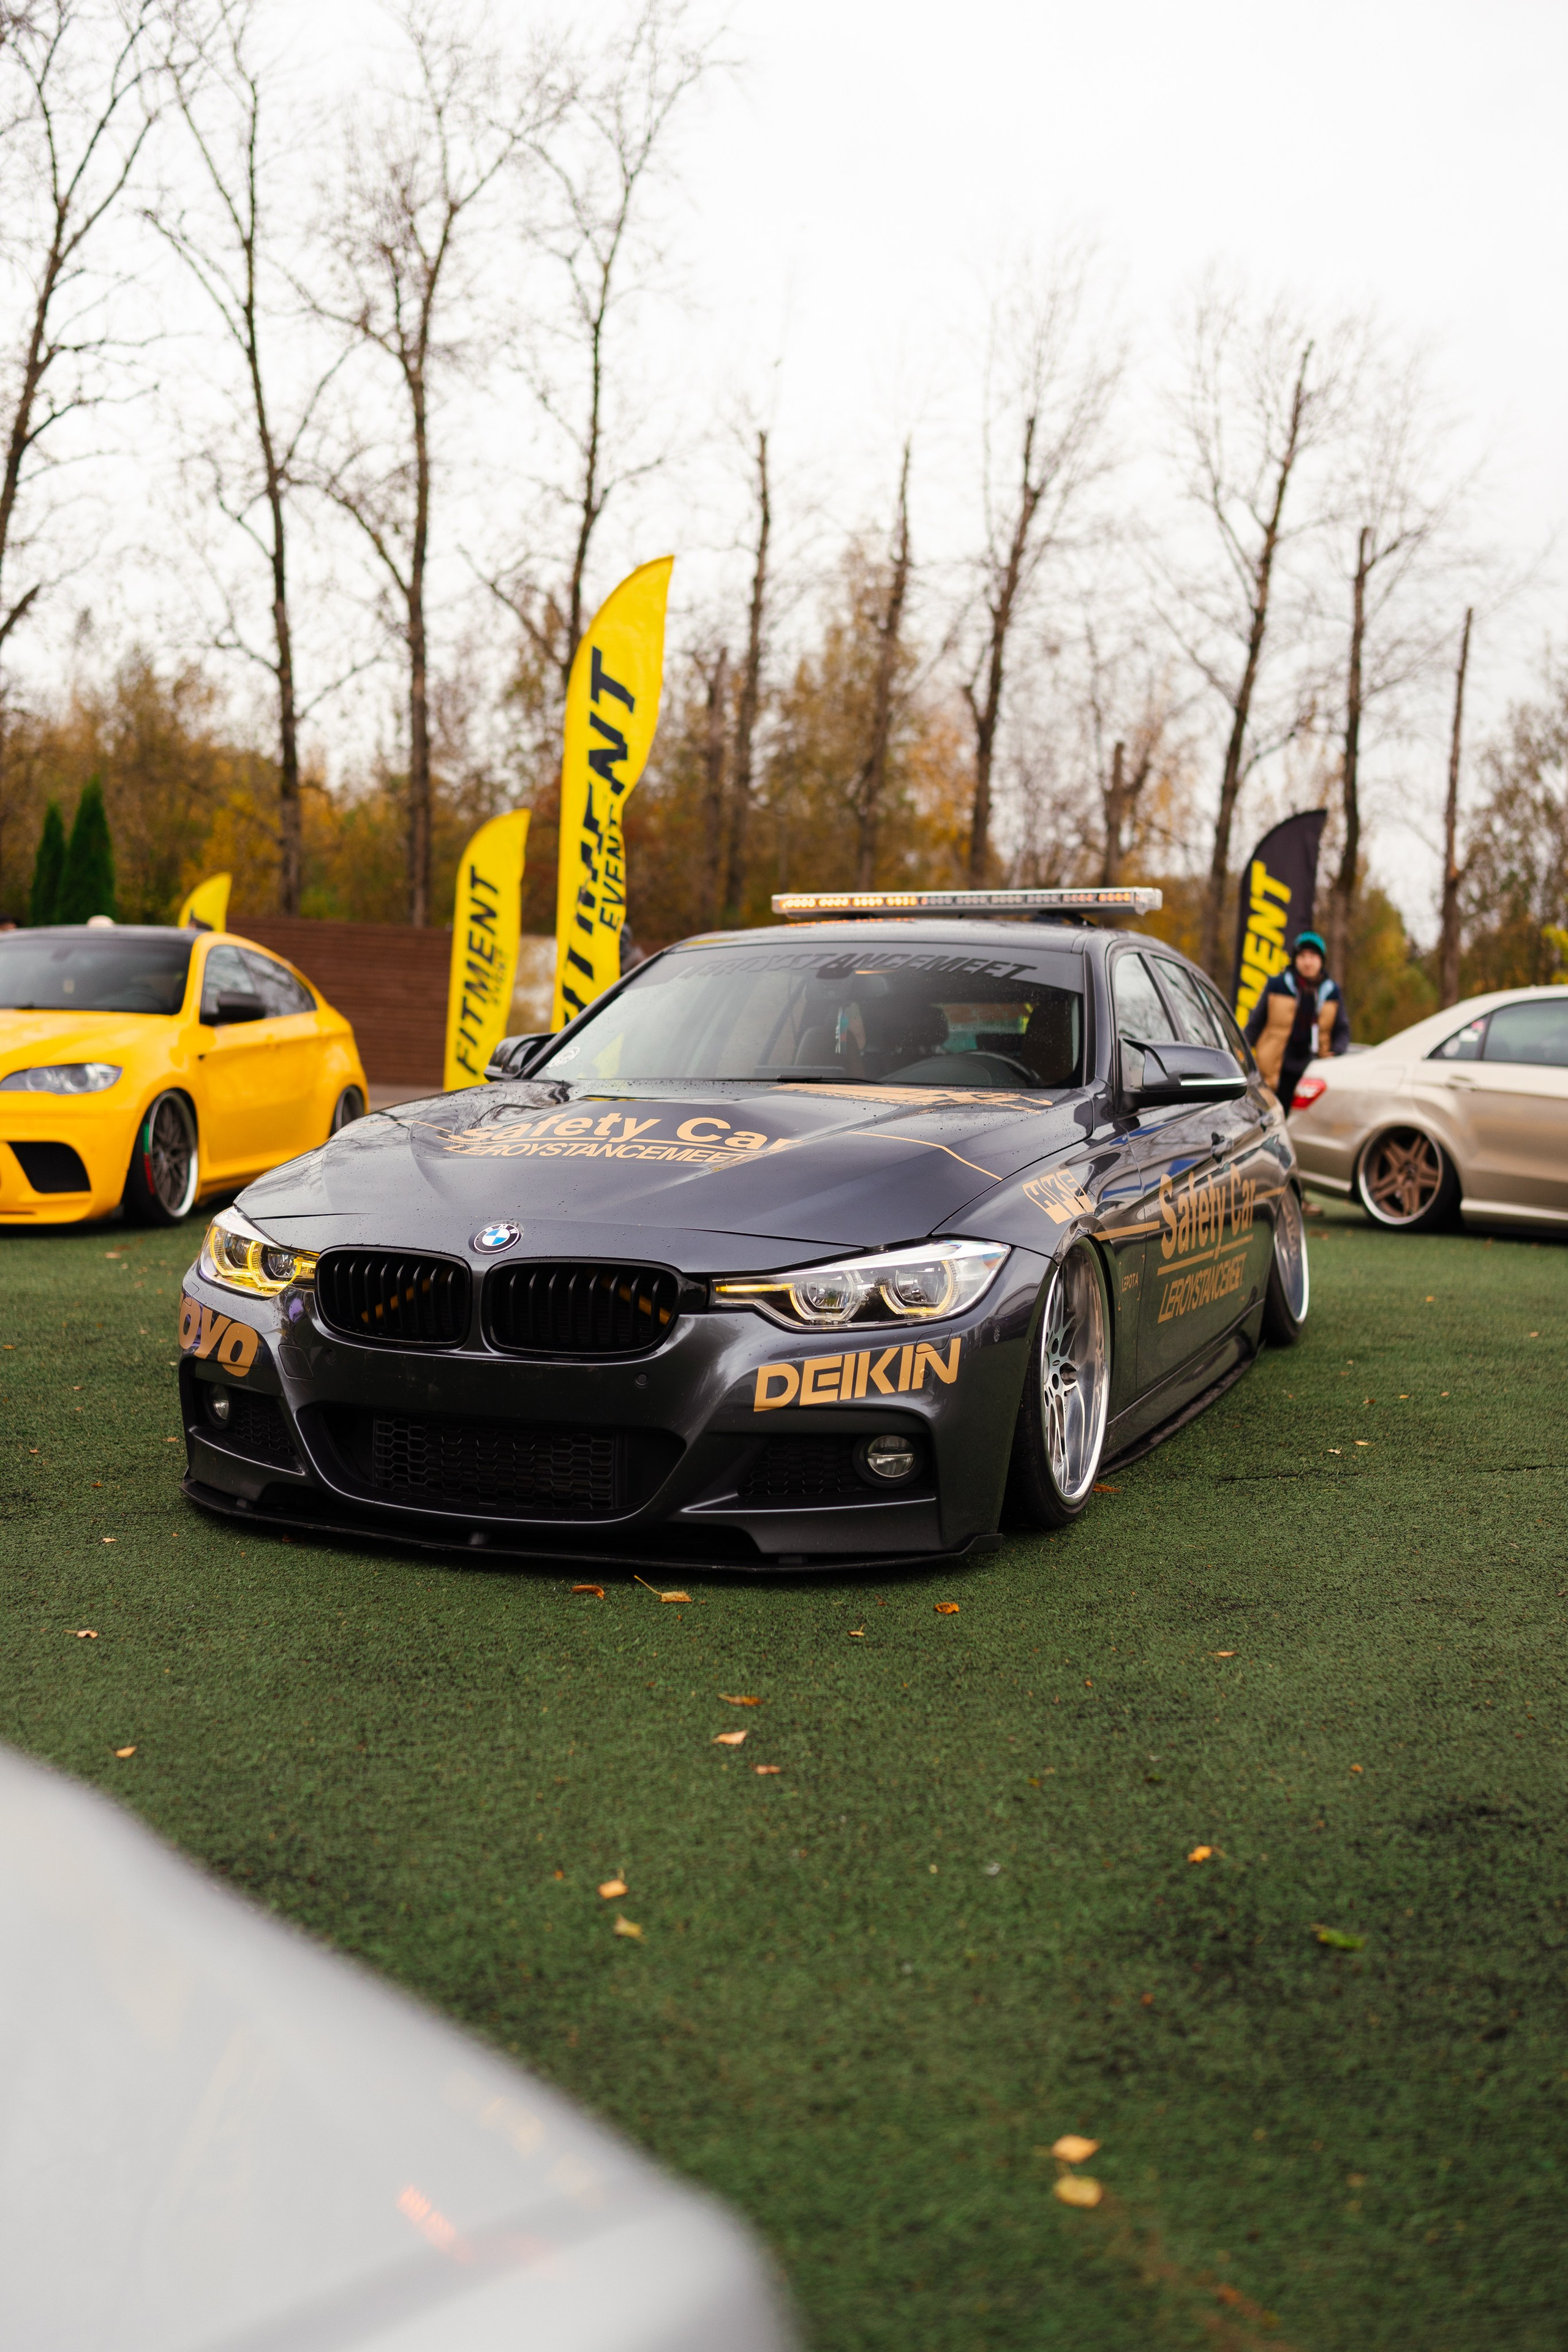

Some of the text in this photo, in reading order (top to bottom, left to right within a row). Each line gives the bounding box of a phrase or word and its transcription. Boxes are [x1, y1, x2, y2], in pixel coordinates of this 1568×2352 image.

[562, 645, 635, 1028] ITMENT
[456, 864, 499, 1076] FITMENT
[442, 1142, 760, 1163] LEROYSTANCEMEET
[448, 1112, 802, 1151] Safety Car
[1022, 1169, 1091, 1218] HKS
[1159, 1163, 1256, 1261] Safety Car
[1121, 1271, 1139, 1294] LEPOTA
[1157, 1251, 1248, 1324] LEROYSTANCEMEET
[753, 1338, 962, 1412] DEIKIN
